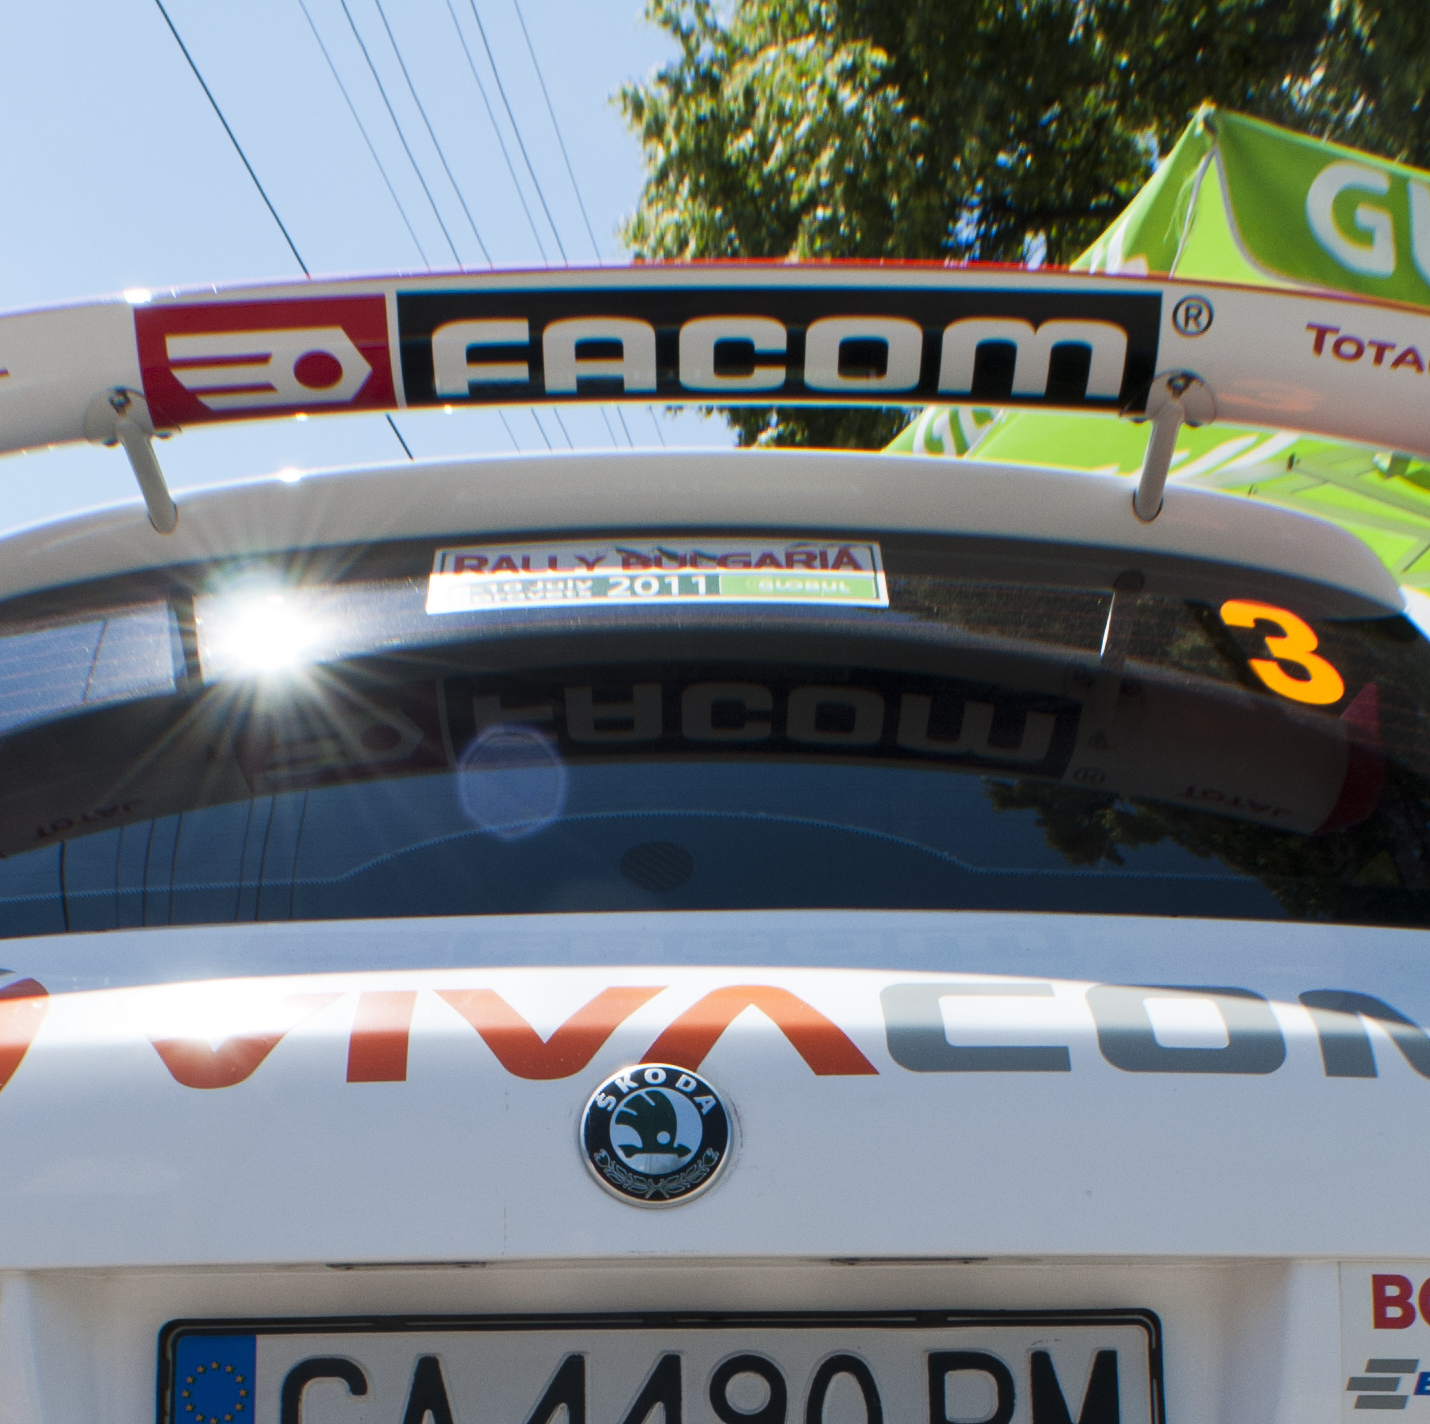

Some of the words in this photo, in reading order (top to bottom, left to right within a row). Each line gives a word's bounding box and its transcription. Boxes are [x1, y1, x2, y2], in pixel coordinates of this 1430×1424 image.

[431, 315, 1128, 401] FACOM
[452, 552, 607, 576] RALLY
[606, 574, 708, 597] 2011
[1219, 600, 1346, 706] 3
